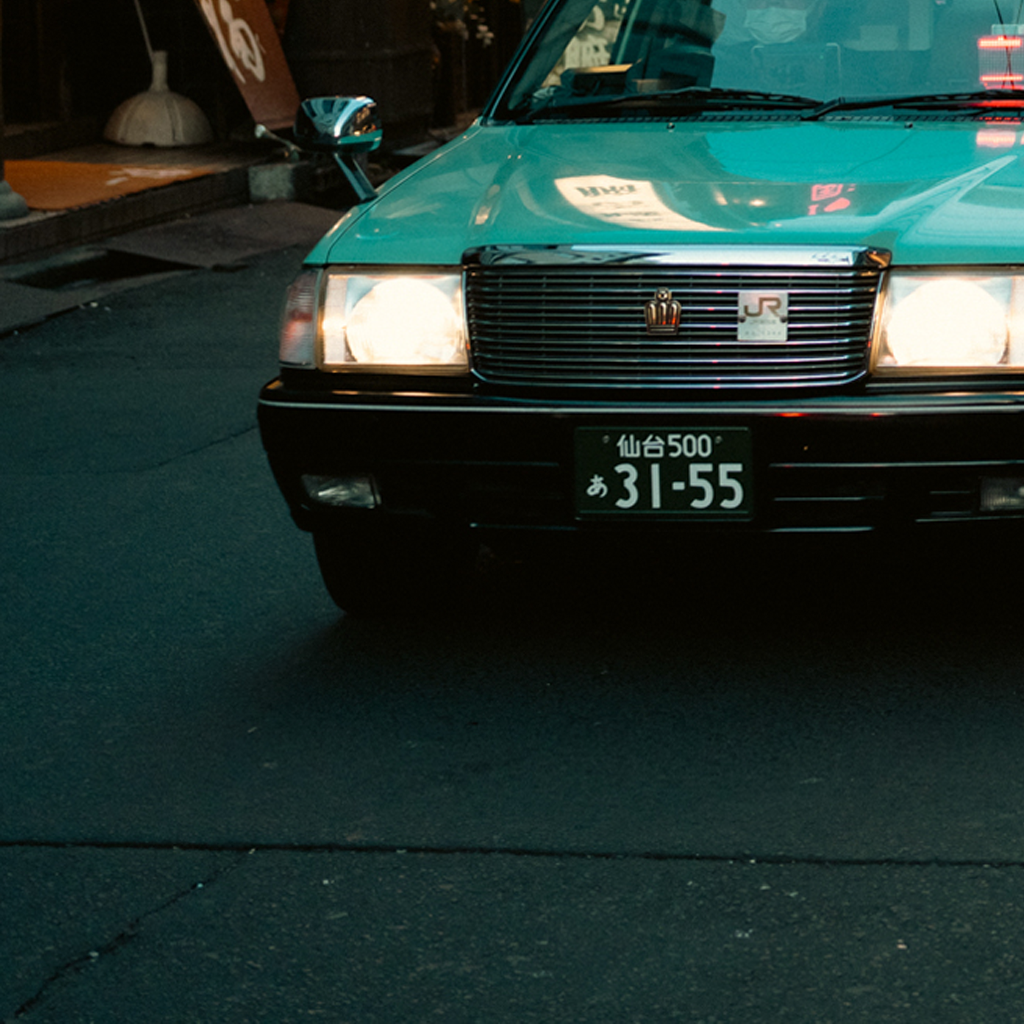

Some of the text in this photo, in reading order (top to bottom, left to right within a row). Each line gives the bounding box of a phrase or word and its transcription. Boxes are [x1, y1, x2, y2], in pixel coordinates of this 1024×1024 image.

[744, 297, 782, 317] JR
[586, 463, 744, 509] あ 31-55
